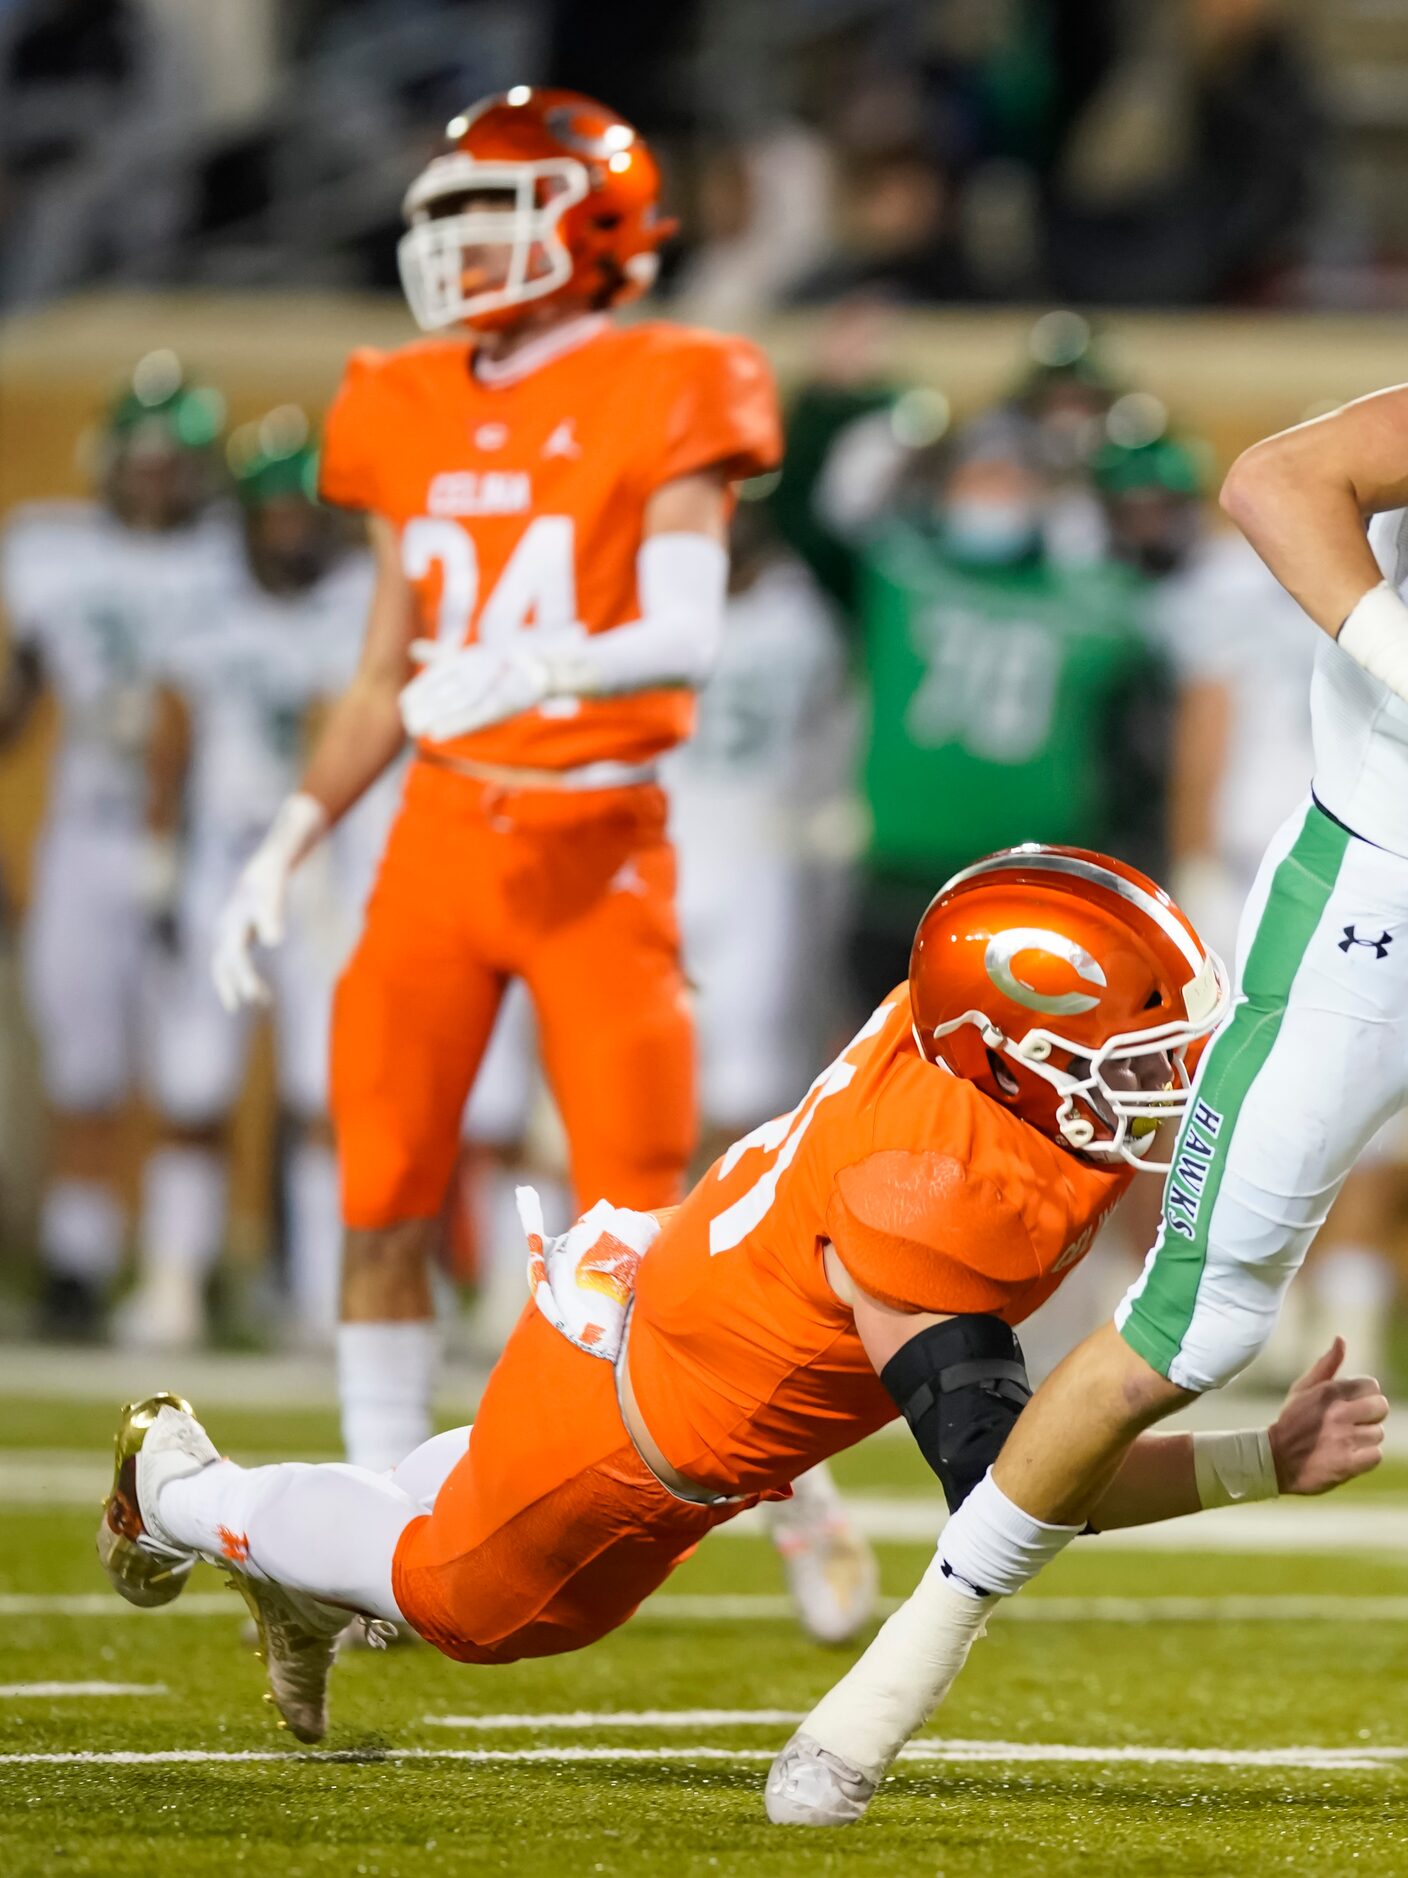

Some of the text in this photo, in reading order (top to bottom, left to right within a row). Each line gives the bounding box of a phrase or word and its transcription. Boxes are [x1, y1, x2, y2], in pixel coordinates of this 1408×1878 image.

[402, 515, 577, 650] 24
[985, 927, 1107, 1015] C
[1166, 1097, 1224, 1241] HAWKS
